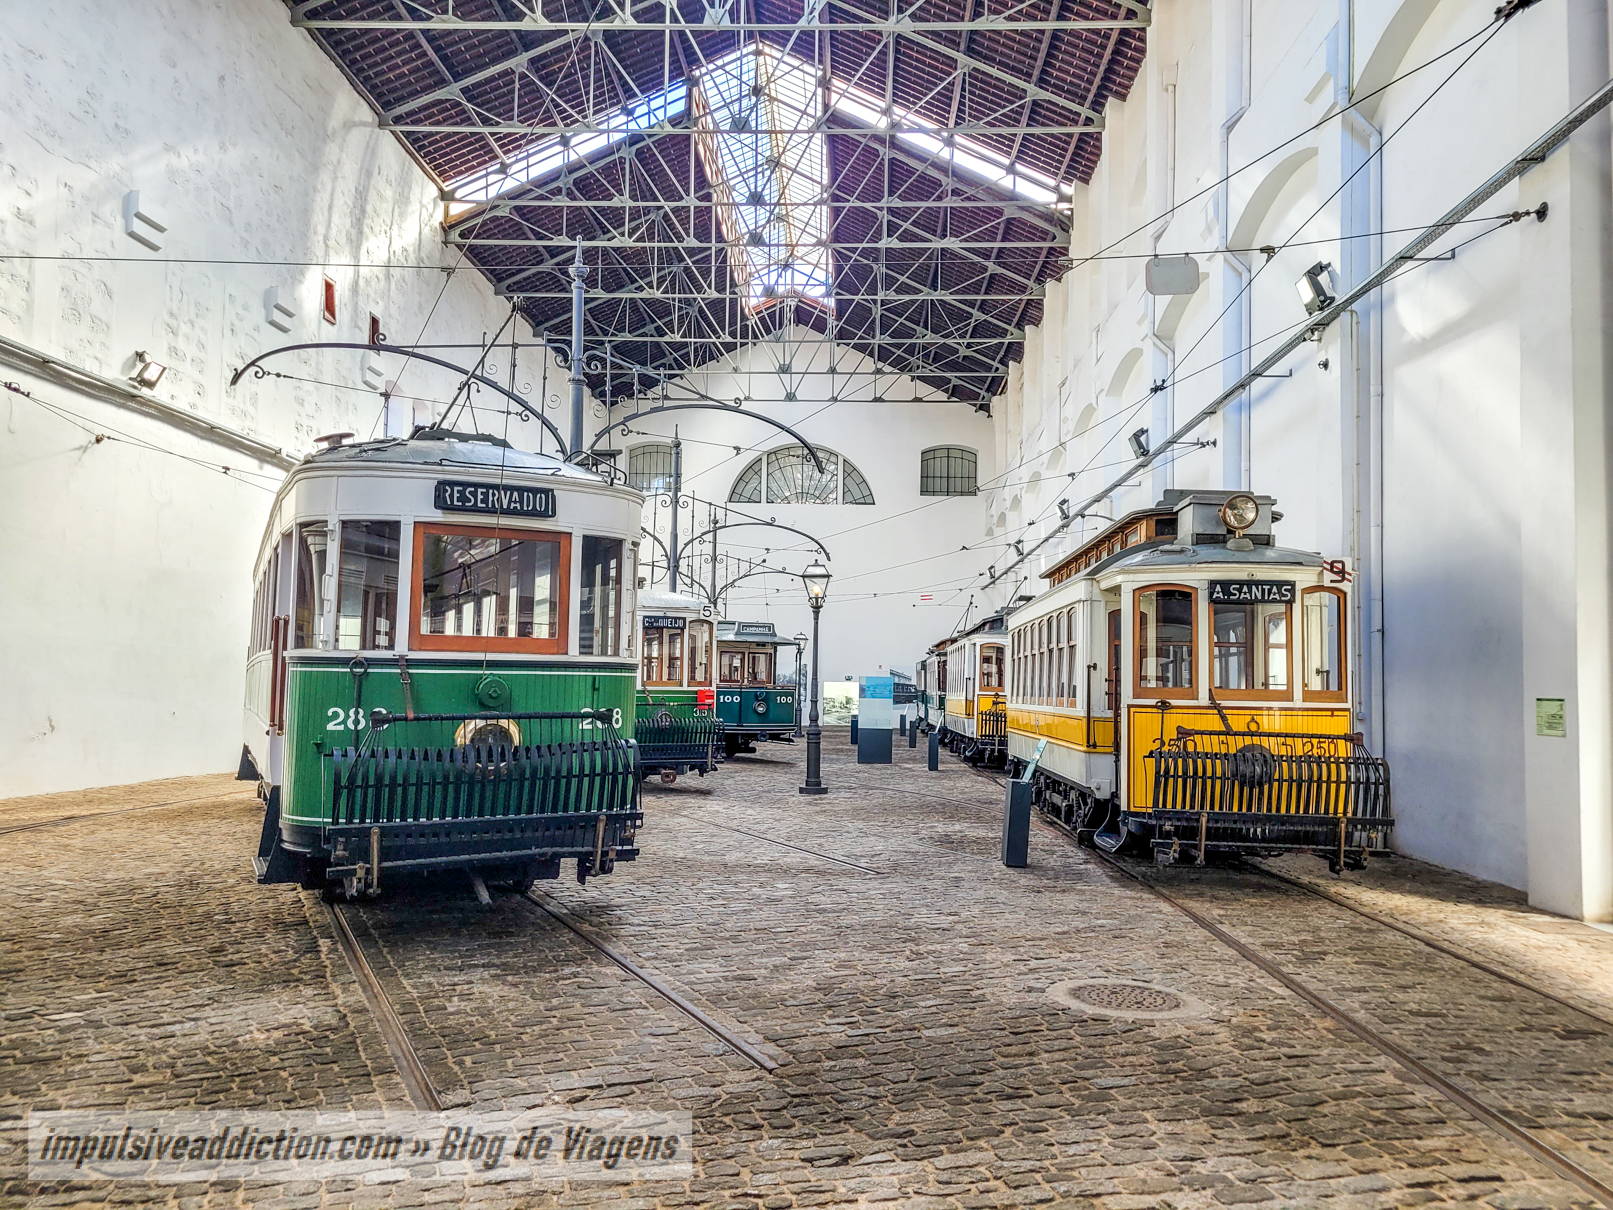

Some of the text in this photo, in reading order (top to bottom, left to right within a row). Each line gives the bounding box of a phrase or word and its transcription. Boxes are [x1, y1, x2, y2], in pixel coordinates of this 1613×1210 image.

[445, 485, 546, 512] RESERVADO
[1329, 559, 1346, 583] 9
[702, 605, 712, 618] 5
[658, 618, 684, 628] QUEIJO
[719, 695, 740, 703] 100
[776, 696, 793, 704] 100
